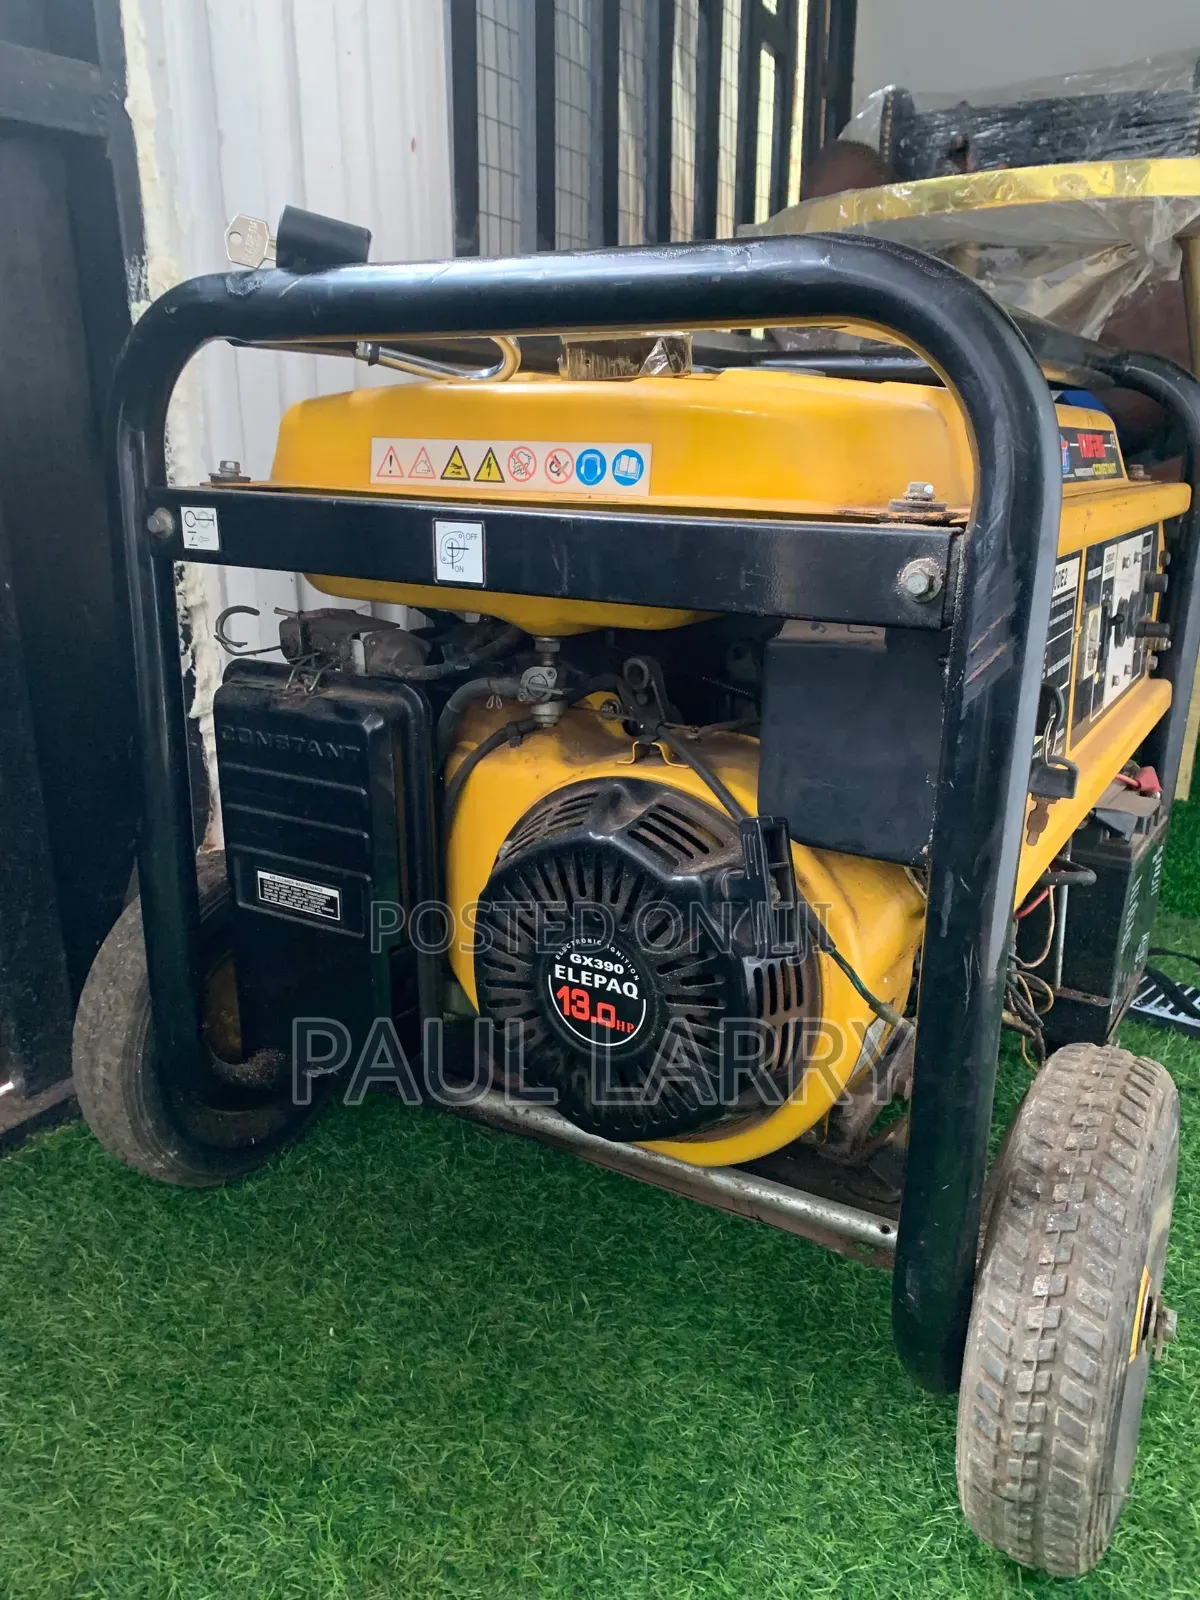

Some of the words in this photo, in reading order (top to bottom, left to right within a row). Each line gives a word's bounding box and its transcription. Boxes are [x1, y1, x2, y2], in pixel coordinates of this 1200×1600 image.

[466, 532, 478, 541] OFF
[454, 565, 464, 573] ON
[220, 724, 361, 760] CONSTANT
[555, 938, 602, 960] ELECTRONIC
[606, 944, 640, 981] IGNITION
[569, 953, 625, 975] GX390
[554, 963, 639, 1000] ELEPAQ
